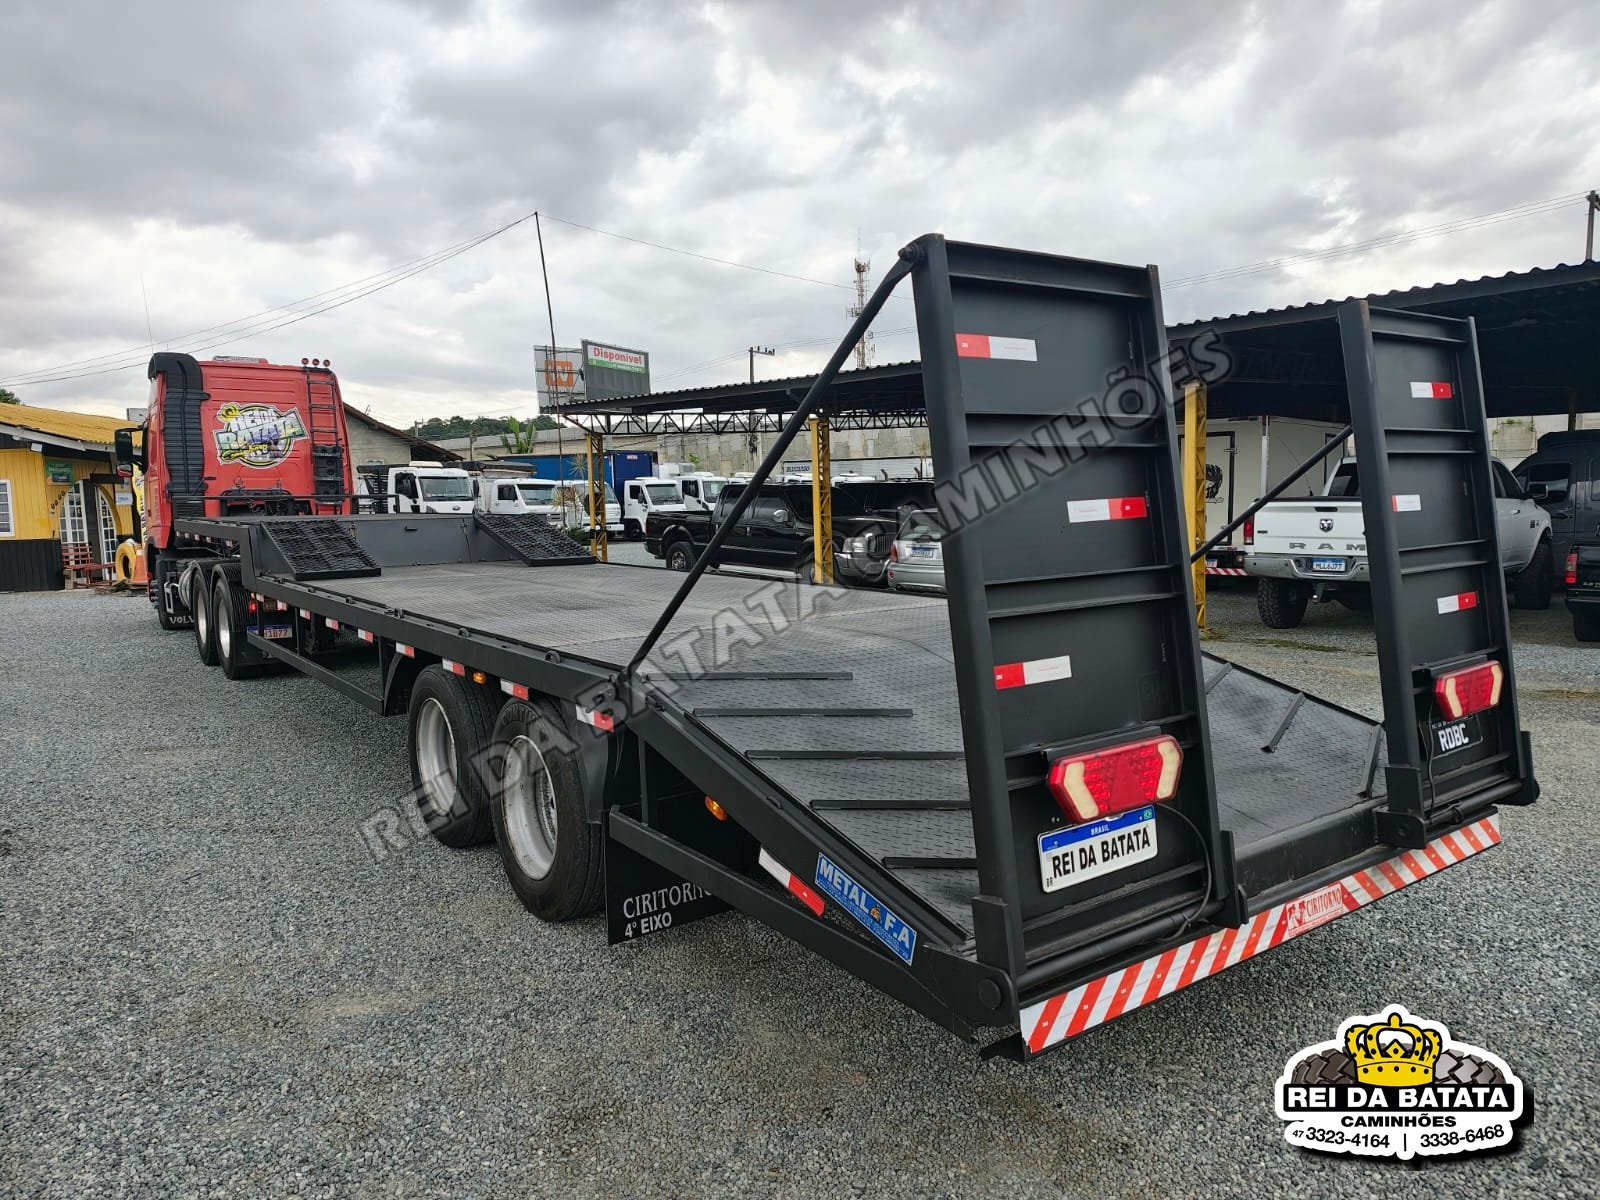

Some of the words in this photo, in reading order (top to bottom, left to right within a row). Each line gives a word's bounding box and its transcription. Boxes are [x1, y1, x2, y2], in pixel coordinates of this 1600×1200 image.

[1289, 543, 1366, 551] RAM
[1438, 723, 1469, 752] RDBC
[1090, 824, 1110, 836] BRASIL
[1051, 850, 1076, 879] REI
[1079, 844, 1098, 870] DA
[623, 882, 712, 919] CIRITORN
[819, 858, 870, 914] METAL
[1306, 887, 1341, 917] CIRITORNO
[640, 911, 672, 934] EIXO
